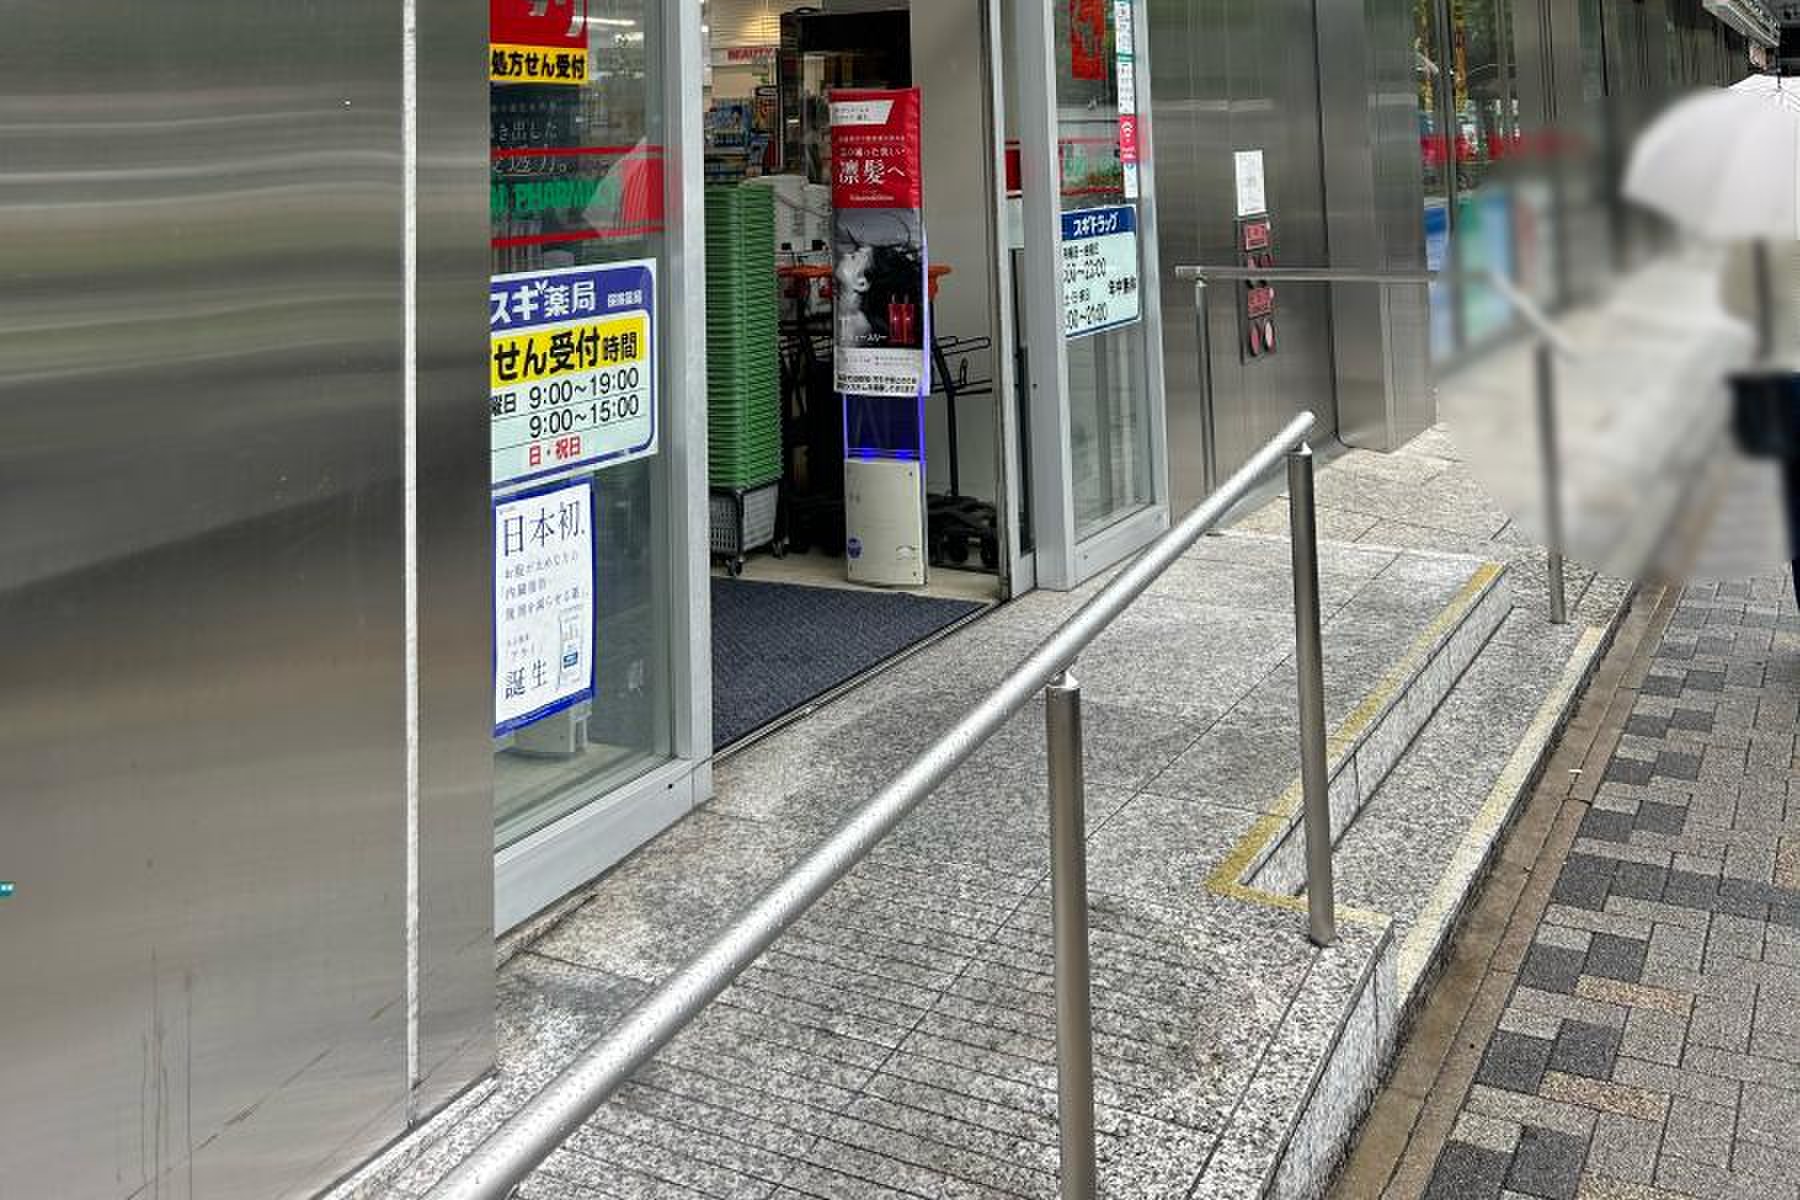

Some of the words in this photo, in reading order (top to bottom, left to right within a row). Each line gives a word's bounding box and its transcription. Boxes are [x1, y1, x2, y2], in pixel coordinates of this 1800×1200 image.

[491, 49, 586, 79] 処方せん受付
[1073, 211, 1119, 237] スギドラッグ
[490, 280, 596, 325] スギ薬局
